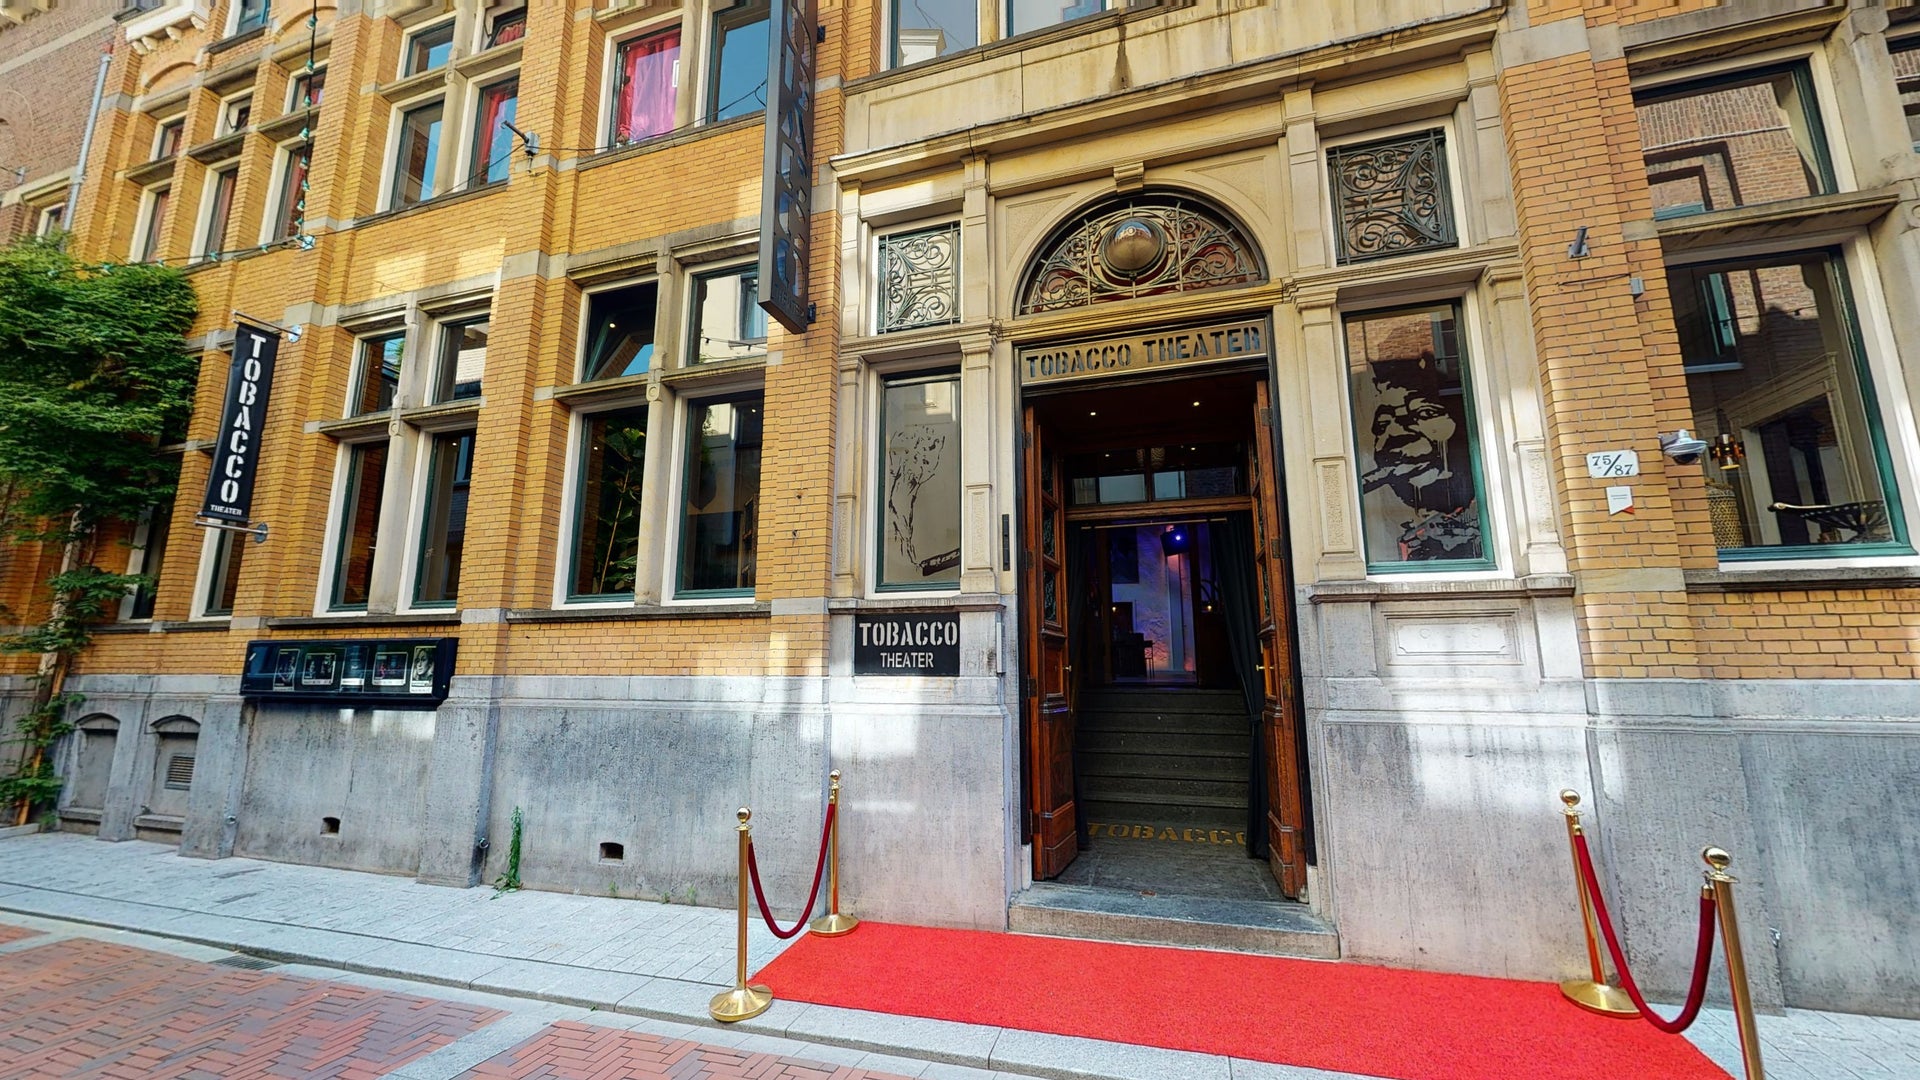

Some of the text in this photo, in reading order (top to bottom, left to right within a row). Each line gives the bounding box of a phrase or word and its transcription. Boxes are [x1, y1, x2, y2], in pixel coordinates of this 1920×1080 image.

[776, 0, 813, 298] OBACCO
[1026, 326, 1261, 378] TOBACCO THEATER
[220, 333, 267, 503] TOBACCO
[1591, 454, 1633, 476] 75/87
[210, 504, 242, 516] THEATER
[859, 621, 958, 646] TOBACCO
[880, 652, 934, 668] THEATER
